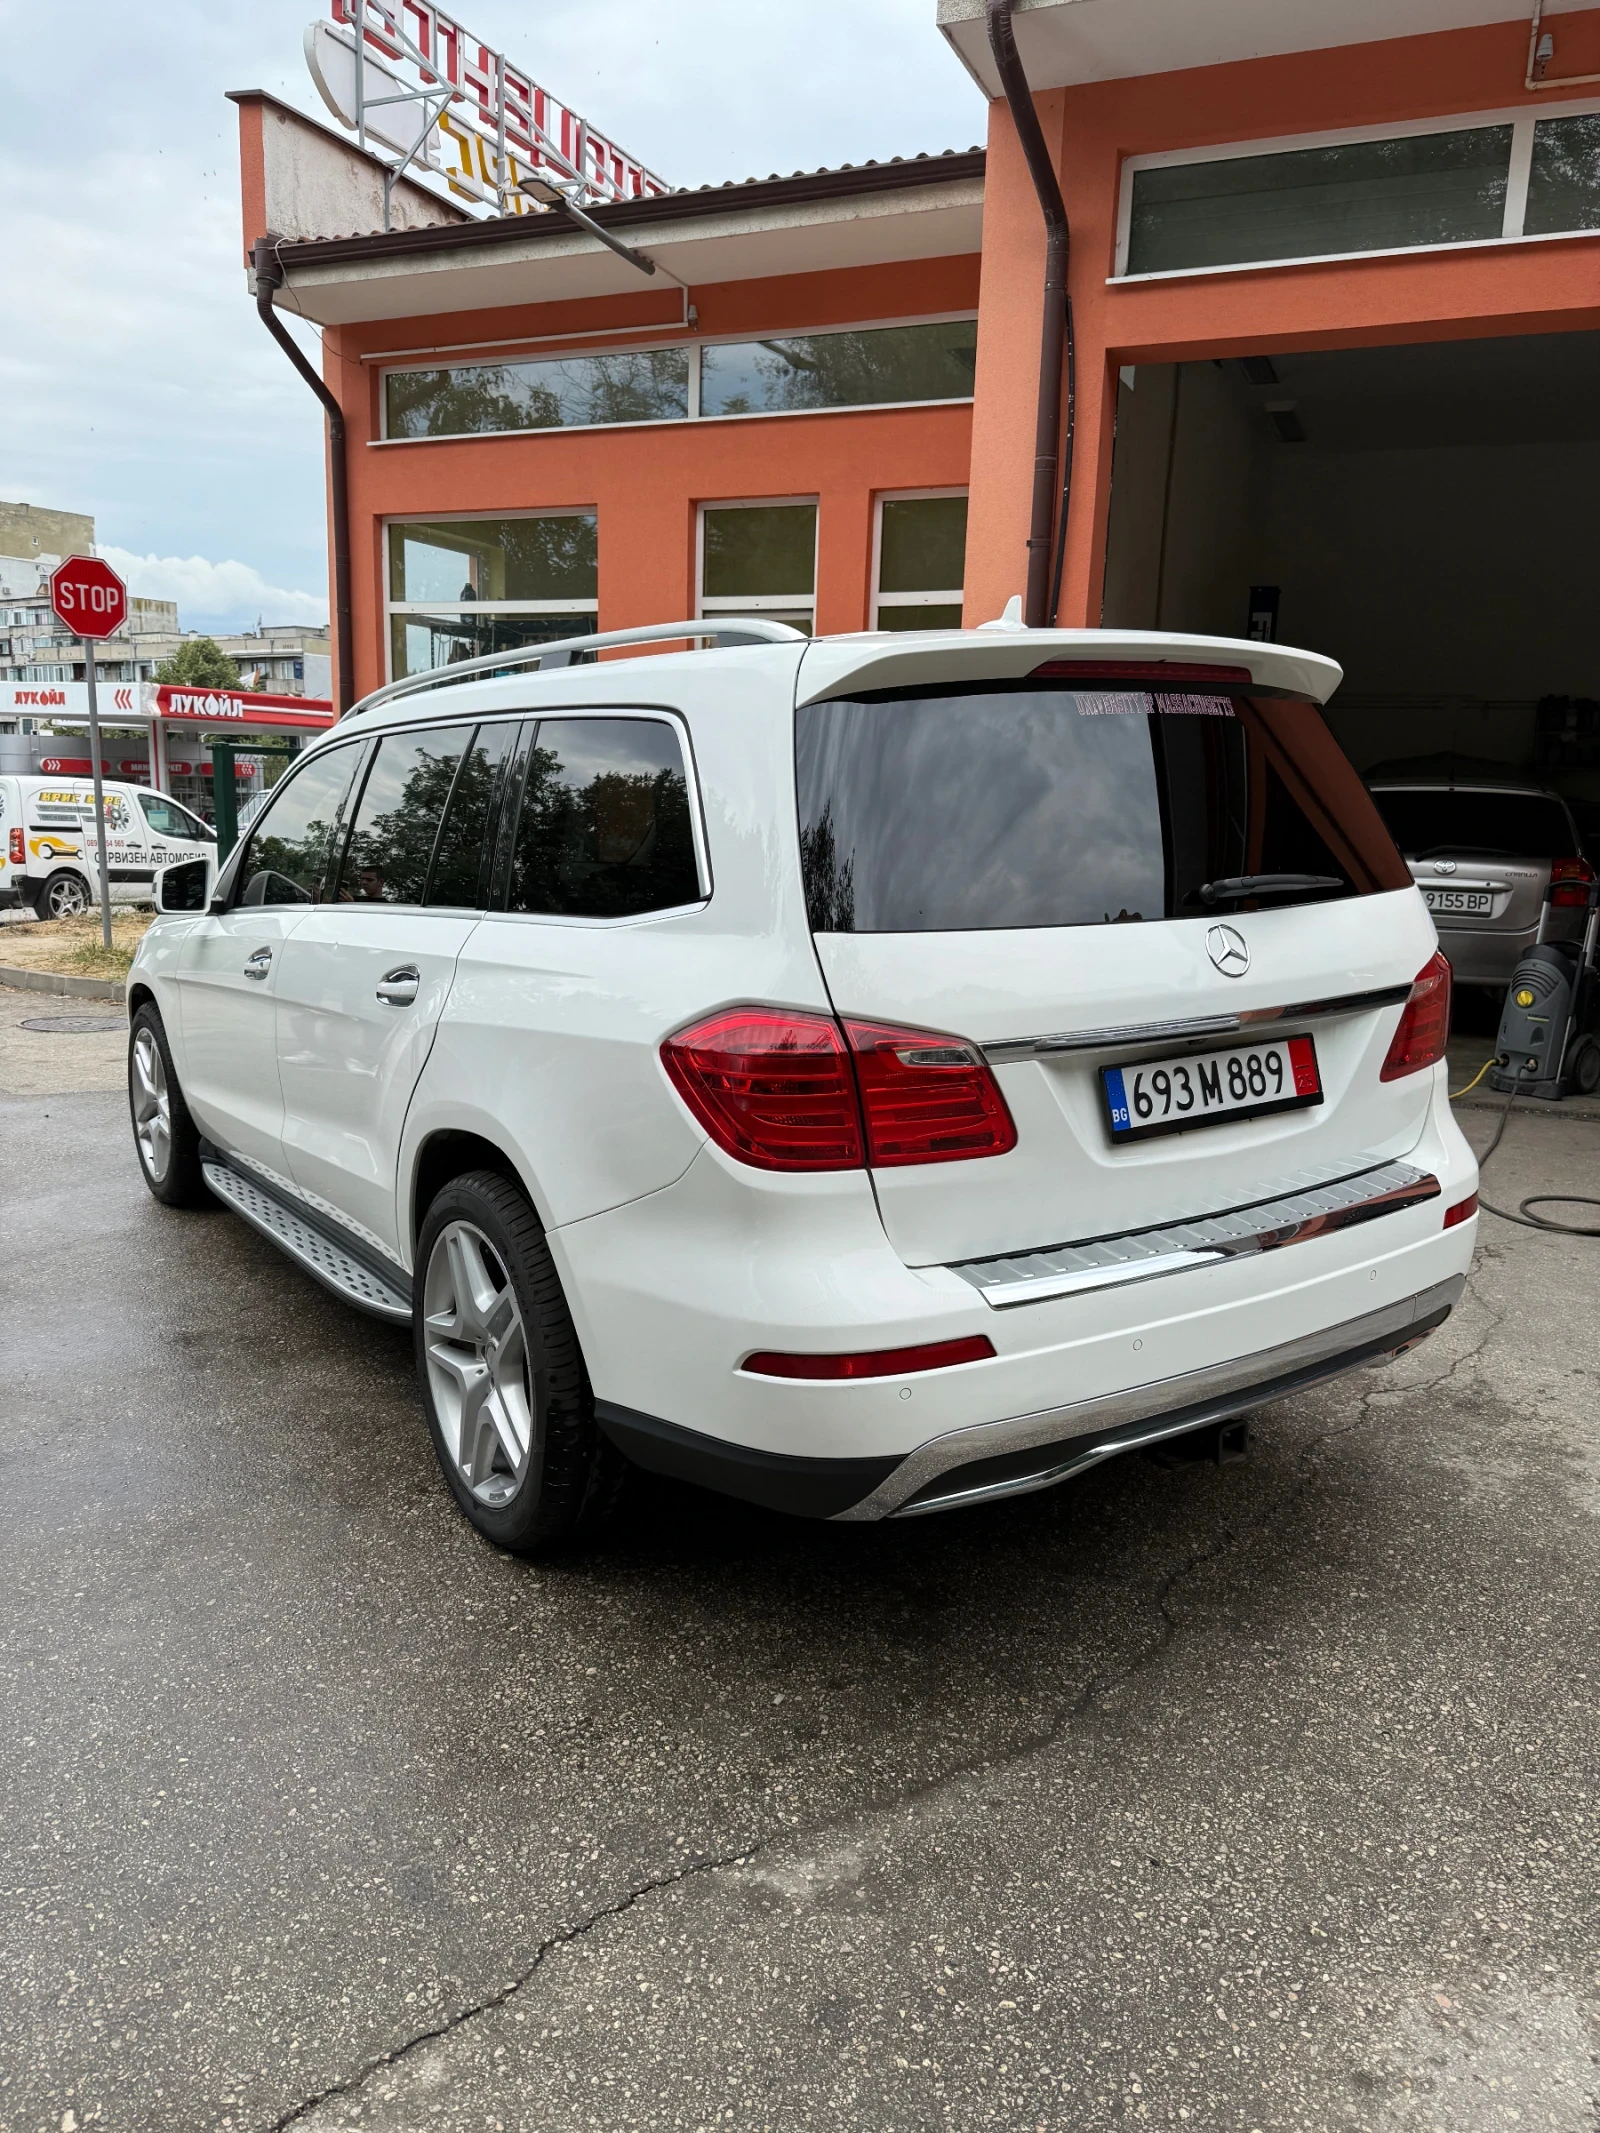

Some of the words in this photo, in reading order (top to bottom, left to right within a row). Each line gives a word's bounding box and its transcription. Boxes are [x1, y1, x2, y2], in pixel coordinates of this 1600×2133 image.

[60, 581, 119, 613] STOP
[14, 689, 66, 706] ЛУКОЙЛ
[169, 692, 244, 718] ЛУКОЙЛ
[1074, 693, 1142, 716] UNIVERSITY
[1142, 693, 1155, 714] OF
[1154, 693, 1236, 717] MASSACHUSETTS
[39, 792, 81, 804] КРИС
[84, 793, 123, 806] КРС
[94, 852, 148, 864] СРВИЗЕН
[1426, 892, 1464, 909] 9155
[1467, 894, 1489, 910] BP
[1112, 1108, 1128, 1124] BG
[1133, 1066, 1195, 1118] 693
[1197, 1060, 1224, 1107] M
[1226, 1050, 1283, 1101] 889
